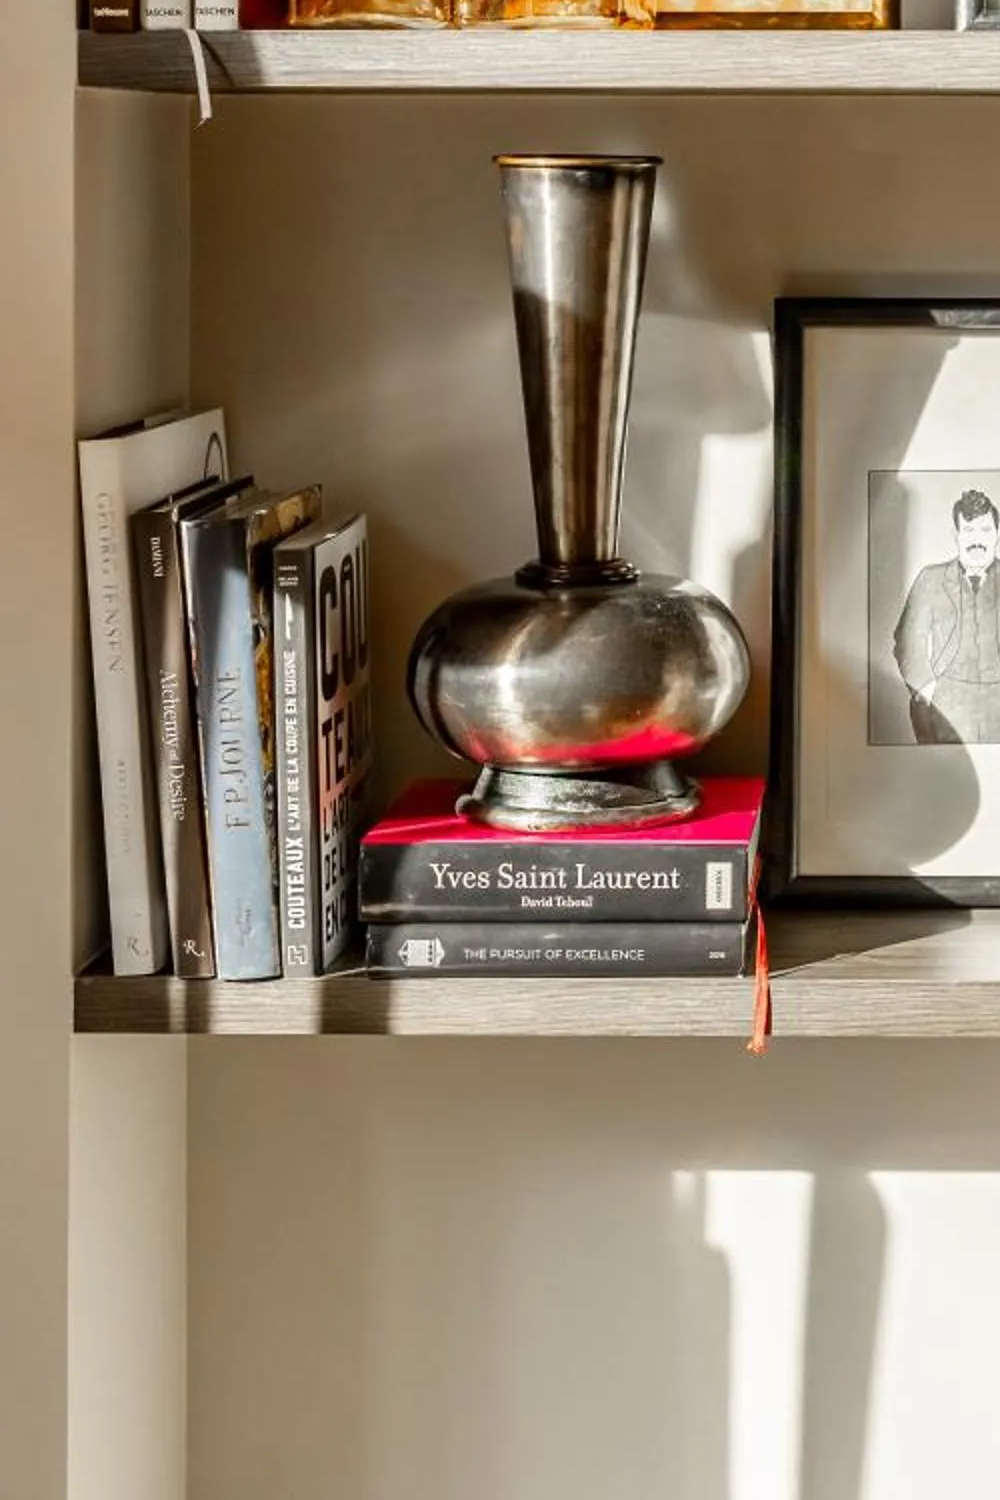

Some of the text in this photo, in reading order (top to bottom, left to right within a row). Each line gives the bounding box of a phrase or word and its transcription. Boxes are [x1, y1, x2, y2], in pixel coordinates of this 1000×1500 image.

[150, 536, 165, 578] DAMIANI
[158, 669, 180, 750] Alchemy
[284, 698, 297, 713] EN
[285, 718, 299, 754] COUPE
[286, 758, 300, 773] LA
[166, 764, 186, 821] Desire
[284, 837, 306, 929] COUTEAUX
[429, 862, 491, 890] Yves
[497, 862, 567, 890] Saint
[574, 863, 681, 890] Laurent
[521, 895, 594, 908] David Teboul
[463, 948, 645, 962] THE PURSUIT OF EXCELLENCE
